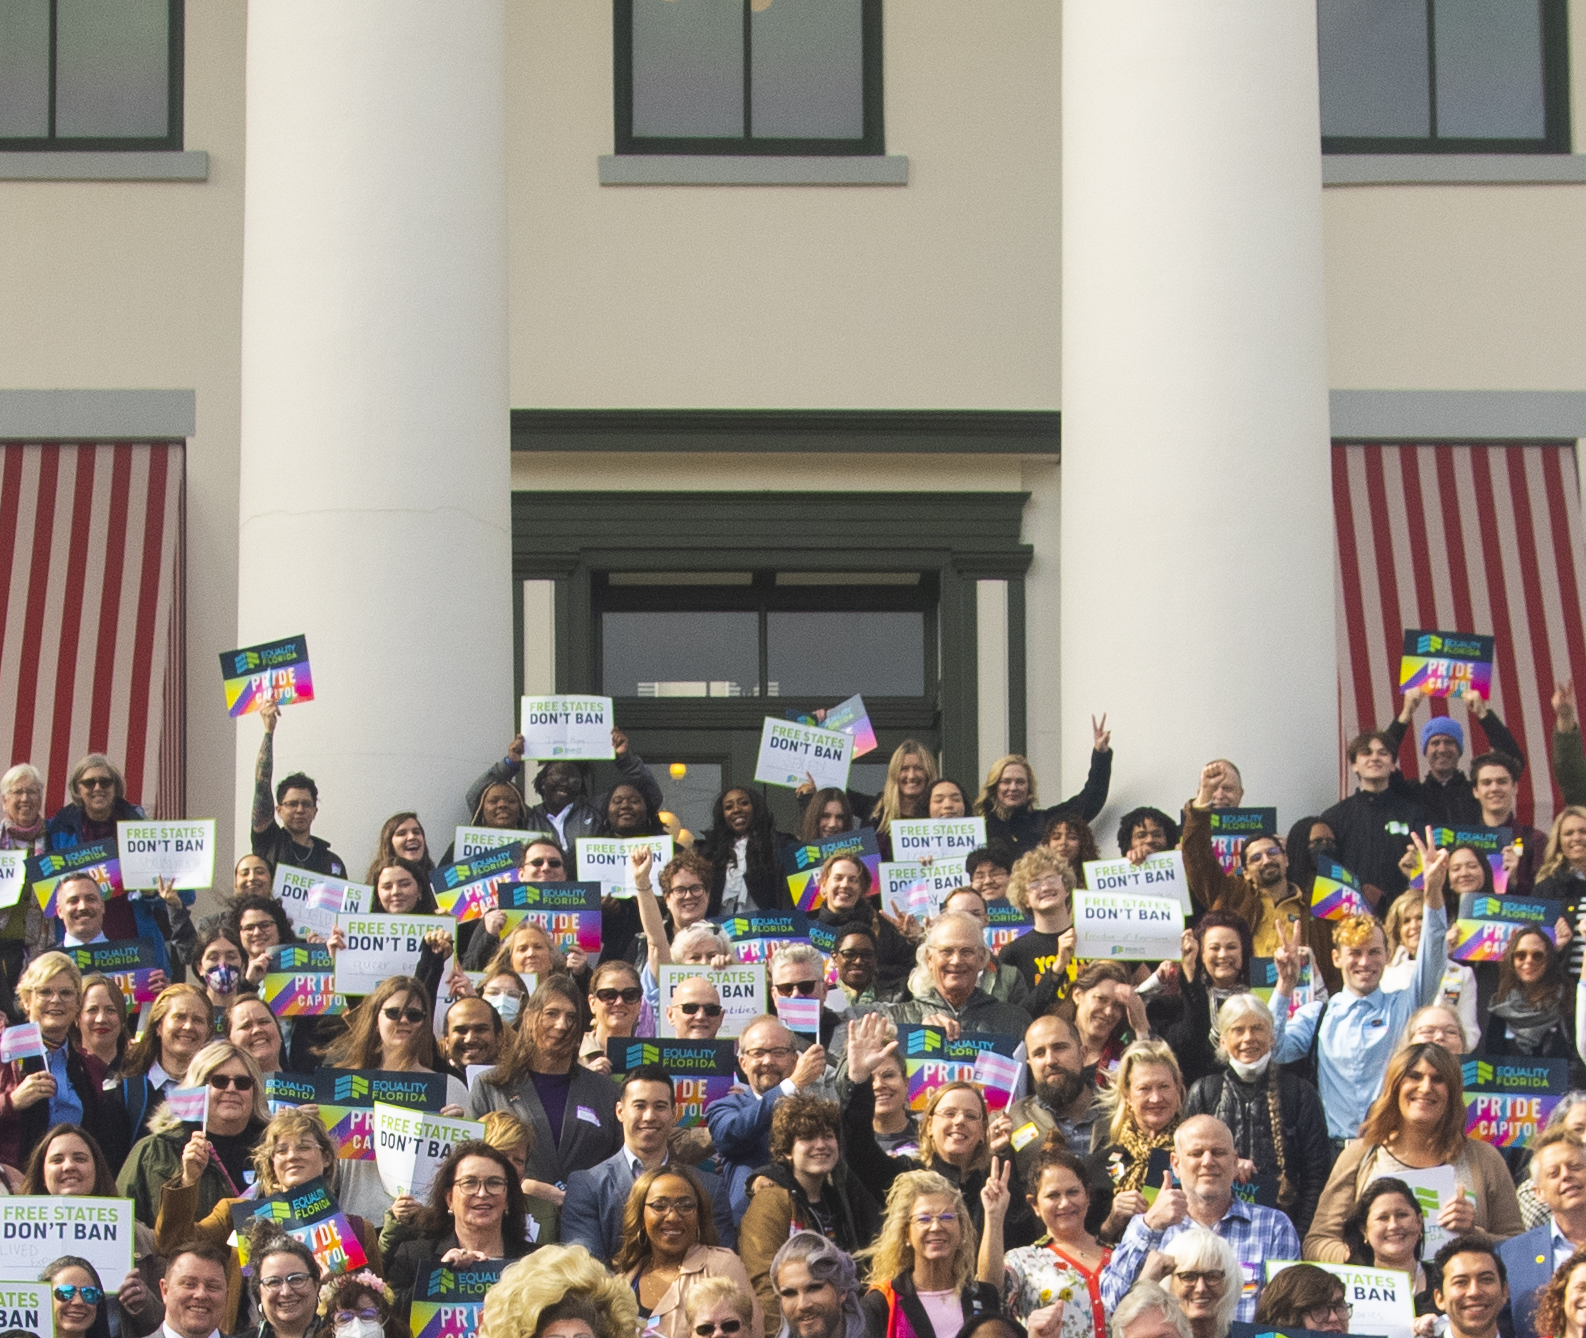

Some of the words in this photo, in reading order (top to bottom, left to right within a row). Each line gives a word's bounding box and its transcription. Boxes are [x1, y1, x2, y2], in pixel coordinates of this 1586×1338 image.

[1427, 660, 1475, 677] PRIDE
[528, 701, 558, 711] FREE
[562, 701, 603, 711] STATES
[529, 712, 571, 724] DON'T
[575, 713, 603, 723] BAN
[770, 723, 801, 739] FREE
[804, 731, 843, 748] STATES
[768, 735, 812, 755] DON'T
[814, 745, 841, 760] BAN
[125, 828, 157, 838] FREE
[160, 827, 205, 838] STATES
[127, 839, 170, 852] DON'T
[175, 839, 204, 851] BAN
[919, 864, 962, 877] STATES
[1094, 864, 1126, 877] FREE
[283, 872, 315, 889] FREE
[933, 875, 963, 888] BAN
[1096, 873, 1141, 889] DON'T
[1144, 869, 1175, 883] BAN
[528, 912, 579, 928] PRIDE
[1085, 907, 1132, 919] DON'T
[347, 921, 385, 934] FREE
[347, 935, 400, 951] DON'T
[722, 984, 754, 997] BAN
[1476, 1096, 1541, 1117] PRIDE
[381, 1115, 410, 1133] FREE
[414, 1122, 470, 1141] STATES
[1479, 1120, 1540, 1136] CAPITOL
[381, 1131, 423, 1154] DON'T
[4, 1206, 47, 1220] FREE
[53, 1206, 120, 1221] STATES
[5, 1221, 66, 1239] DON'T
[73, 1223, 118, 1241] BAN
[1354, 1287, 1396, 1302] BAN
